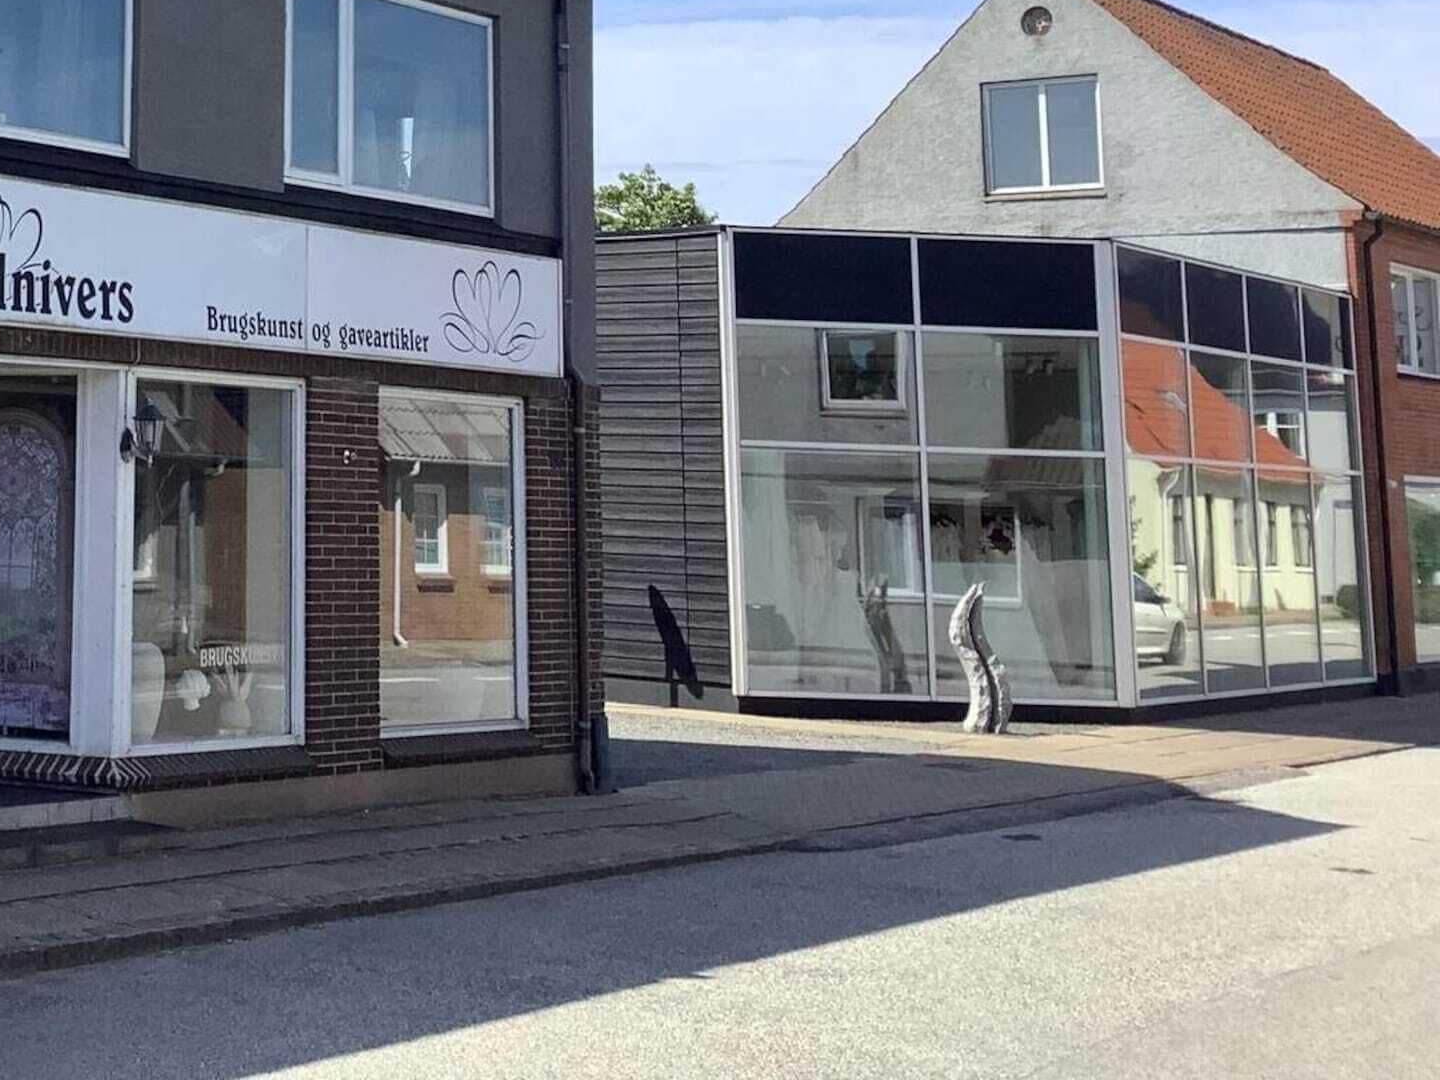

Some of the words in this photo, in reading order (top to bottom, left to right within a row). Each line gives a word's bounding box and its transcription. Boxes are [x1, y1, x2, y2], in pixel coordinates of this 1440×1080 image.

[206, 305, 304, 340] Brugskunst
[311, 323, 331, 350] og
[338, 324, 429, 353] gaveartikler
